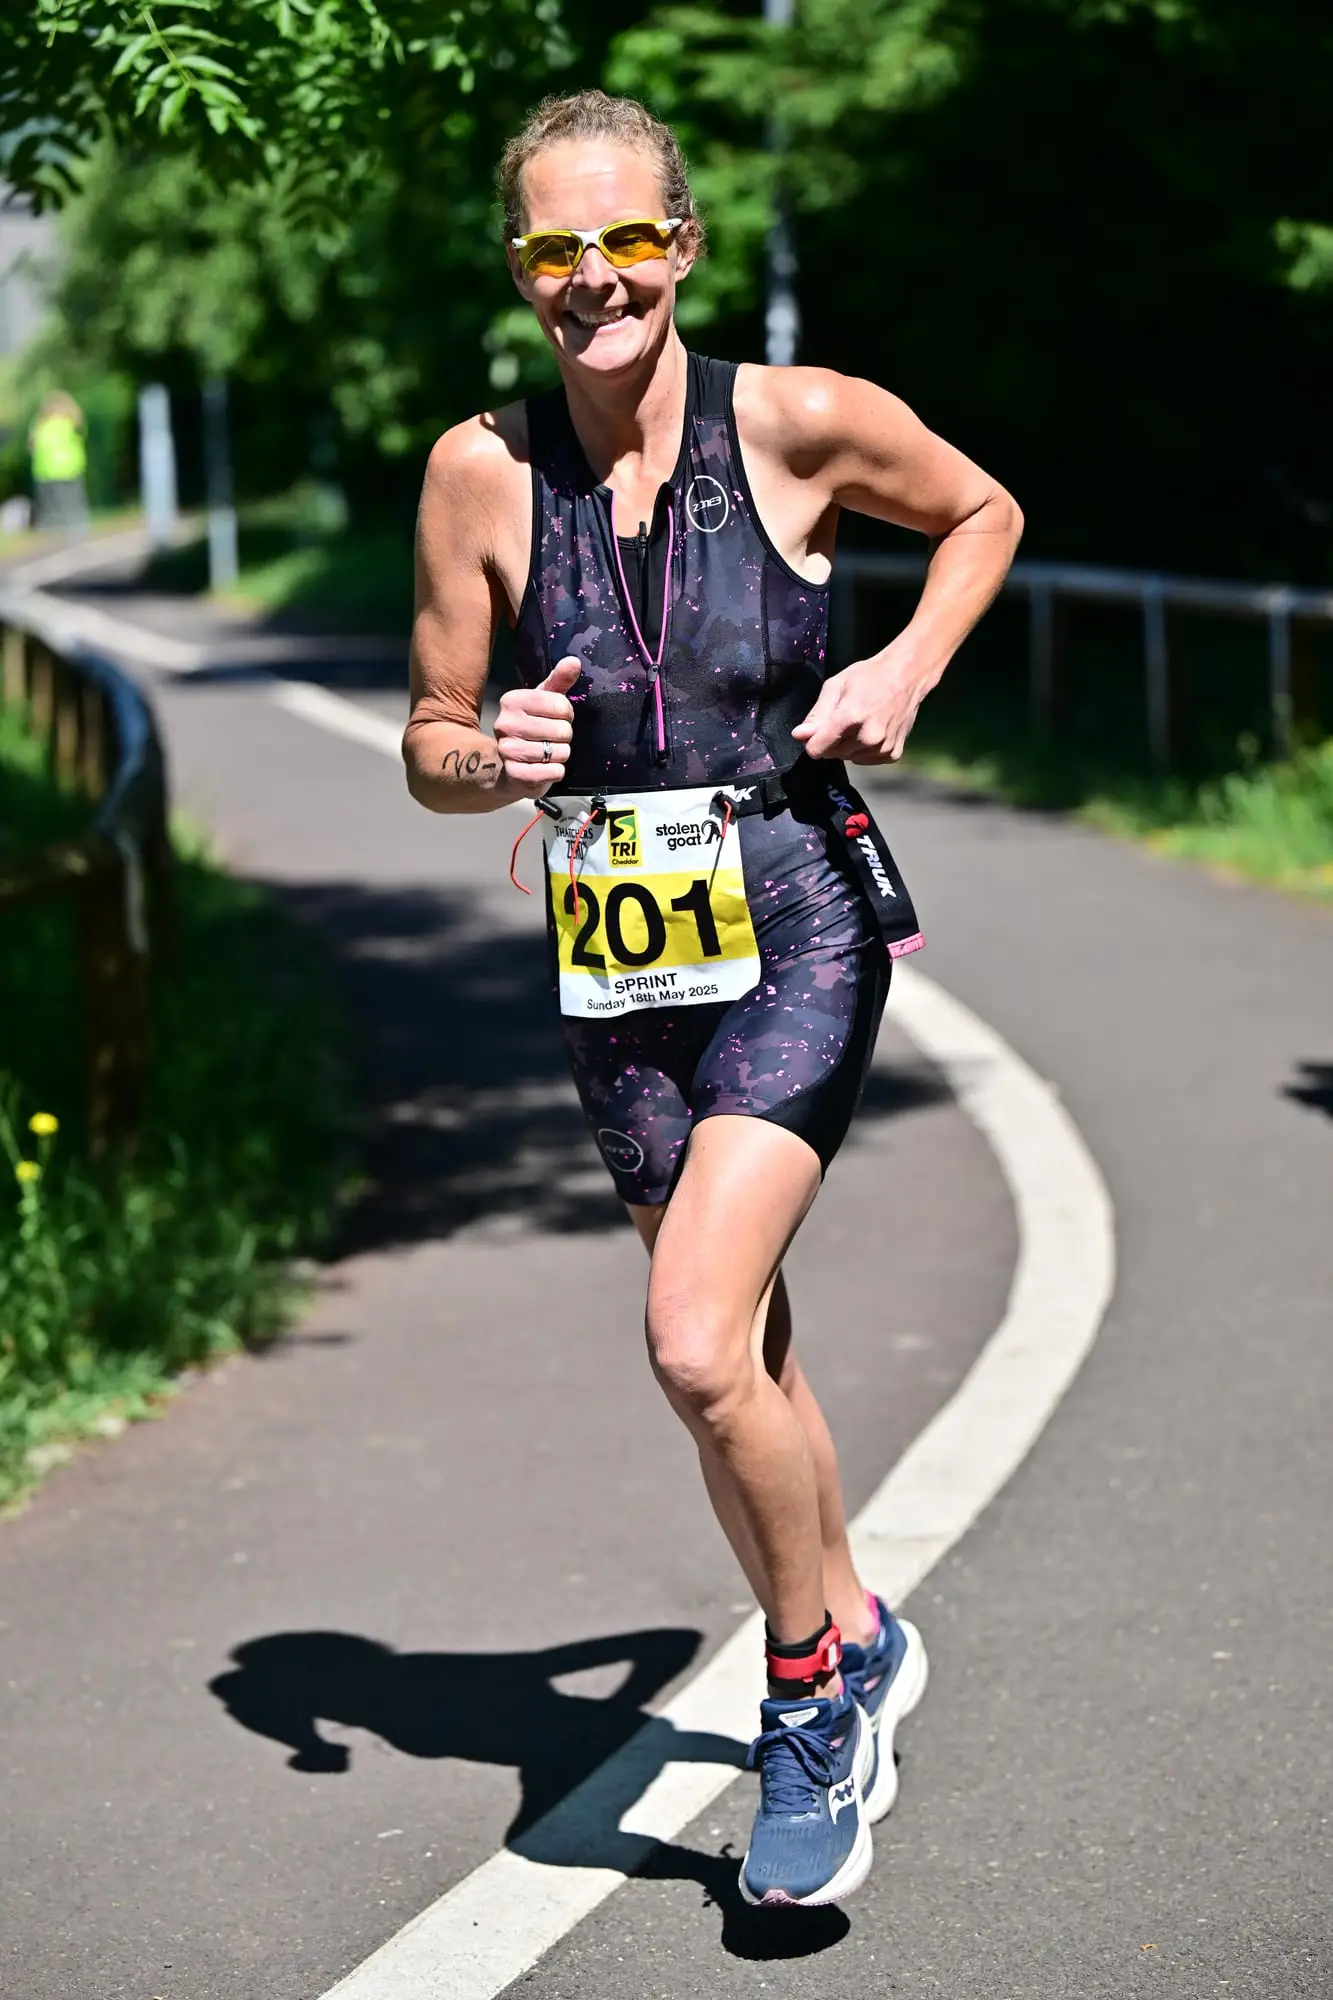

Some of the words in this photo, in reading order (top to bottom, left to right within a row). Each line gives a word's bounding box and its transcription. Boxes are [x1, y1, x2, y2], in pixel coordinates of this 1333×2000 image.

[655, 822, 701, 837] stolen
[611, 842, 636, 857] TRI
[667, 833, 702, 851] goat
[856, 834, 897, 898] TRIUK
[564, 879, 722, 970] 201
[614, 972, 678, 994] SPRINT
[586, 998, 626, 1010] Sunday
[629, 992, 656, 1004] 18th
[659, 990, 685, 1001] May
[688, 984, 719, 997] 2025
